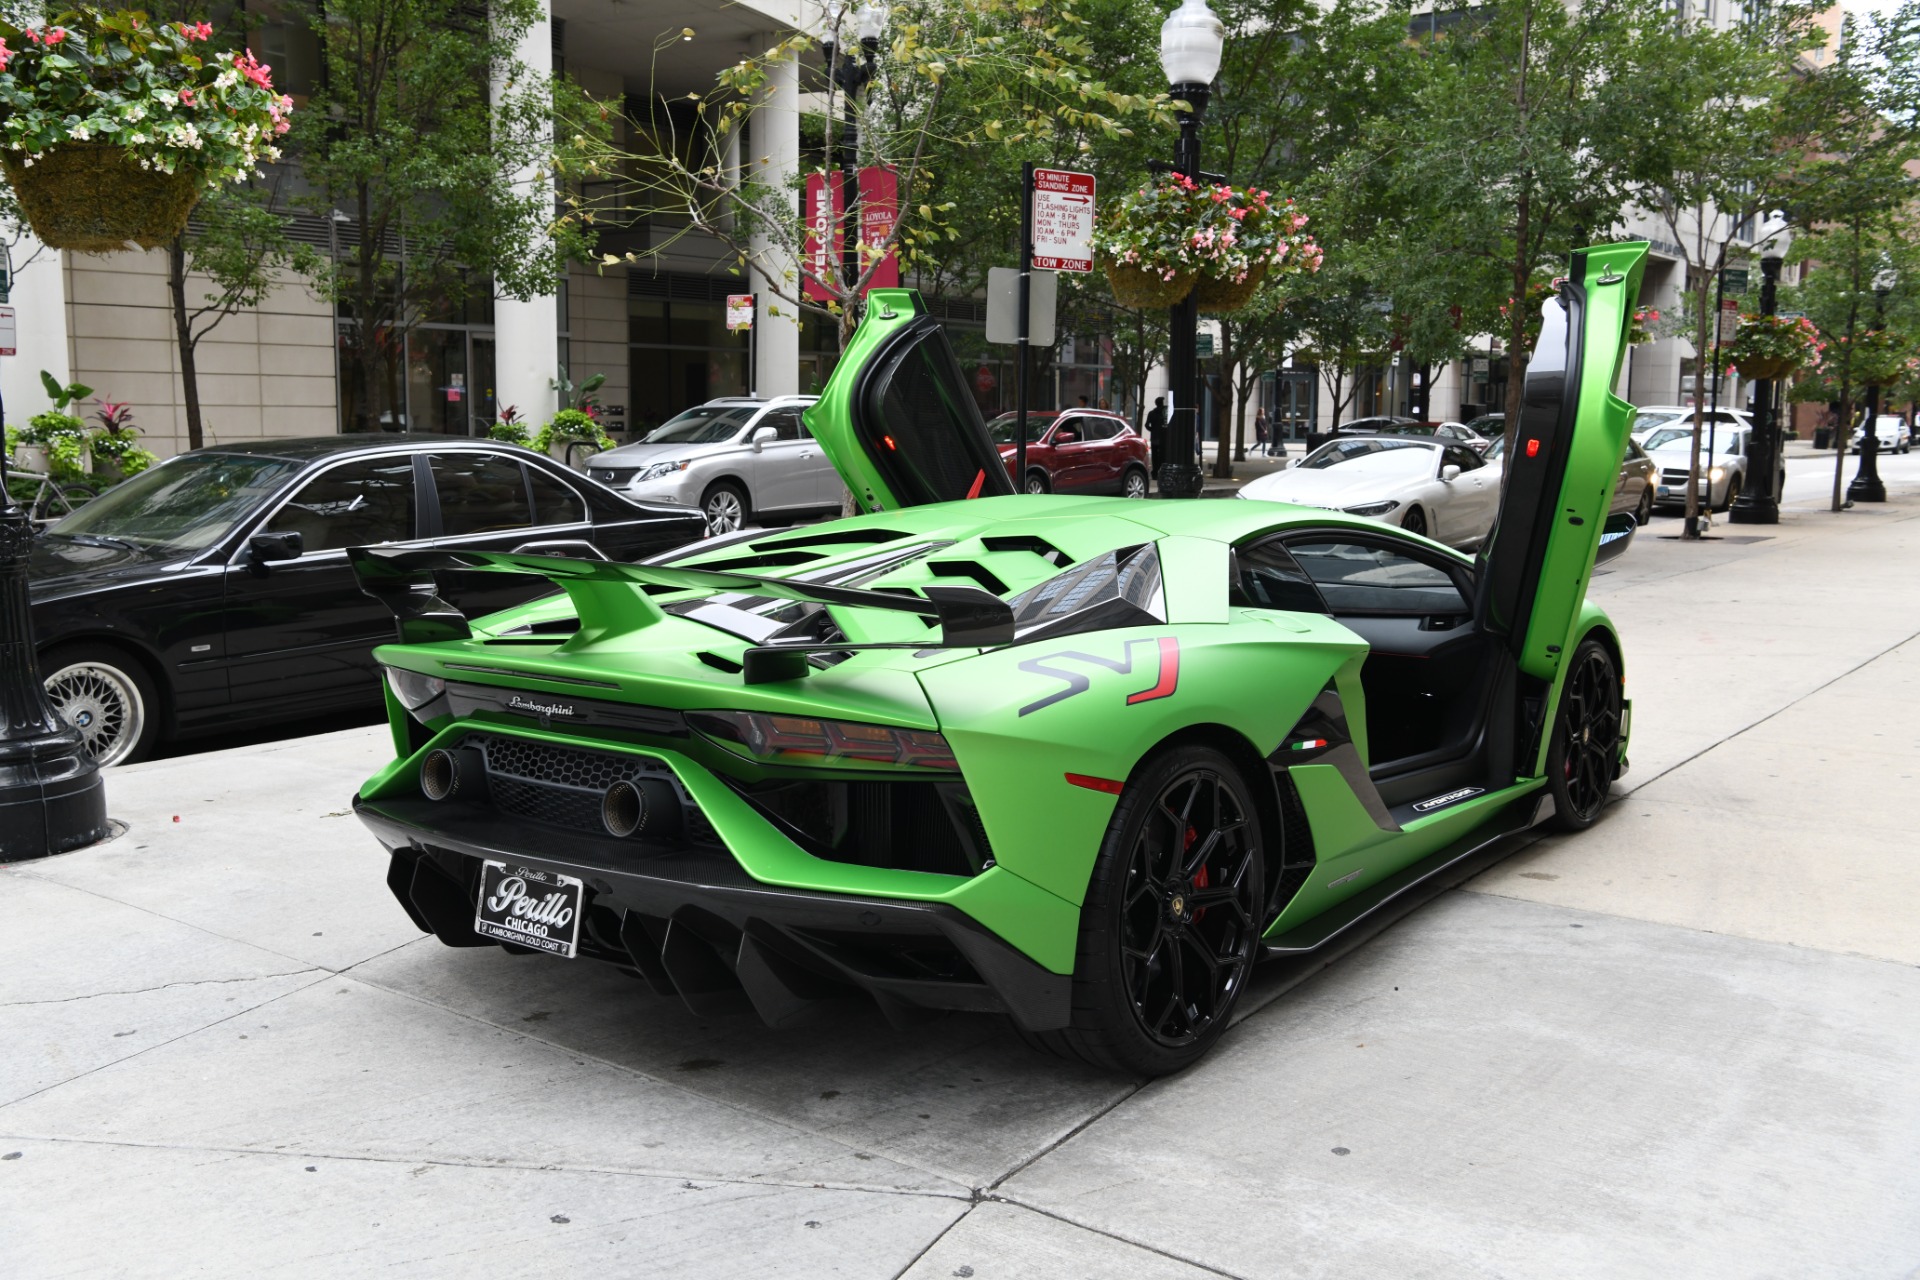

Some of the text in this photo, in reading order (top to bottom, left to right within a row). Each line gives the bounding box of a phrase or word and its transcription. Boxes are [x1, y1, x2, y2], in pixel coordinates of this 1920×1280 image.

[1038, 172, 1070, 183] 15 MINUTE
[1038, 180, 1088, 193] STANDING ZONE
[1037, 194, 1050, 202] USE
[1037, 203, 1090, 215] FLASHING LIGHTS
[866, 211, 892, 221] LOYOLA
[1058, 220, 1080, 230] THURS
[815, 189, 828, 283] WELCOME
[1037, 235, 1048, 243] FRI
[1053, 237, 1067, 245] SUN
[1067, 230, 1076, 238] PM
[1036, 257, 1088, 270] TOW ZONE
[508, 696, 574, 716] Lamborghini
[515, 866, 547, 881] Perillo
[487, 876, 573, 928] Perillo
[505, 916, 548, 937] CHICAGO
[488, 926, 559, 951] LAMBORGHINI GOLD COAST
